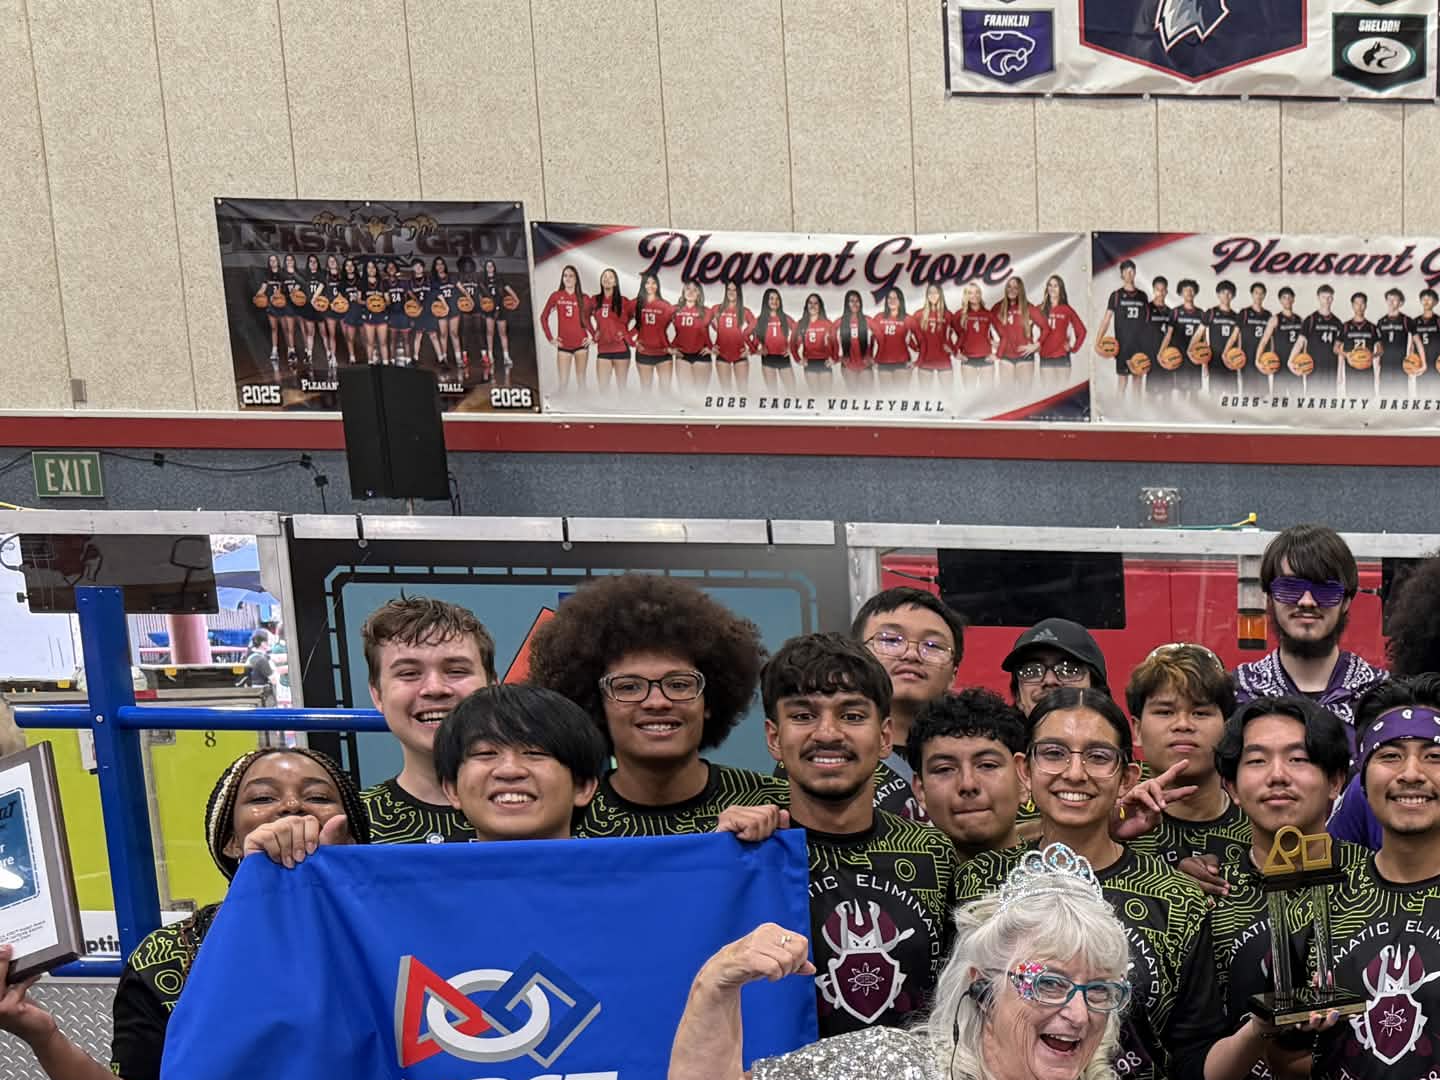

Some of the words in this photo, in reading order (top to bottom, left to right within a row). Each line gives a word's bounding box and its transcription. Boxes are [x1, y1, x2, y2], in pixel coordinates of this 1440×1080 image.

[983, 14, 1030, 28] FRANKLIN
[1358, 19, 1401, 33] SHELDON
[1210, 237, 1417, 277] Pleasant
[638, 231, 860, 287] Pleasant
[864, 236, 1014, 304] Grove
[1127, 307, 1139, 319] 33
[681, 316, 694, 327] 10
[1321, 332, 1333, 343] 44
[241, 385, 282, 405] 2025
[490, 388, 532, 407] 2026
[704, 397, 748, 409] 2025
[759, 397, 815, 410] EAGLE
[827, 398, 945, 412] VOLLEYBALL
[1221, 397, 1289, 409] 2025-26
[1297, 398, 1369, 410] VARSITY
[44, 459, 92, 491] EXIT
[205, 731, 217, 748] 8
